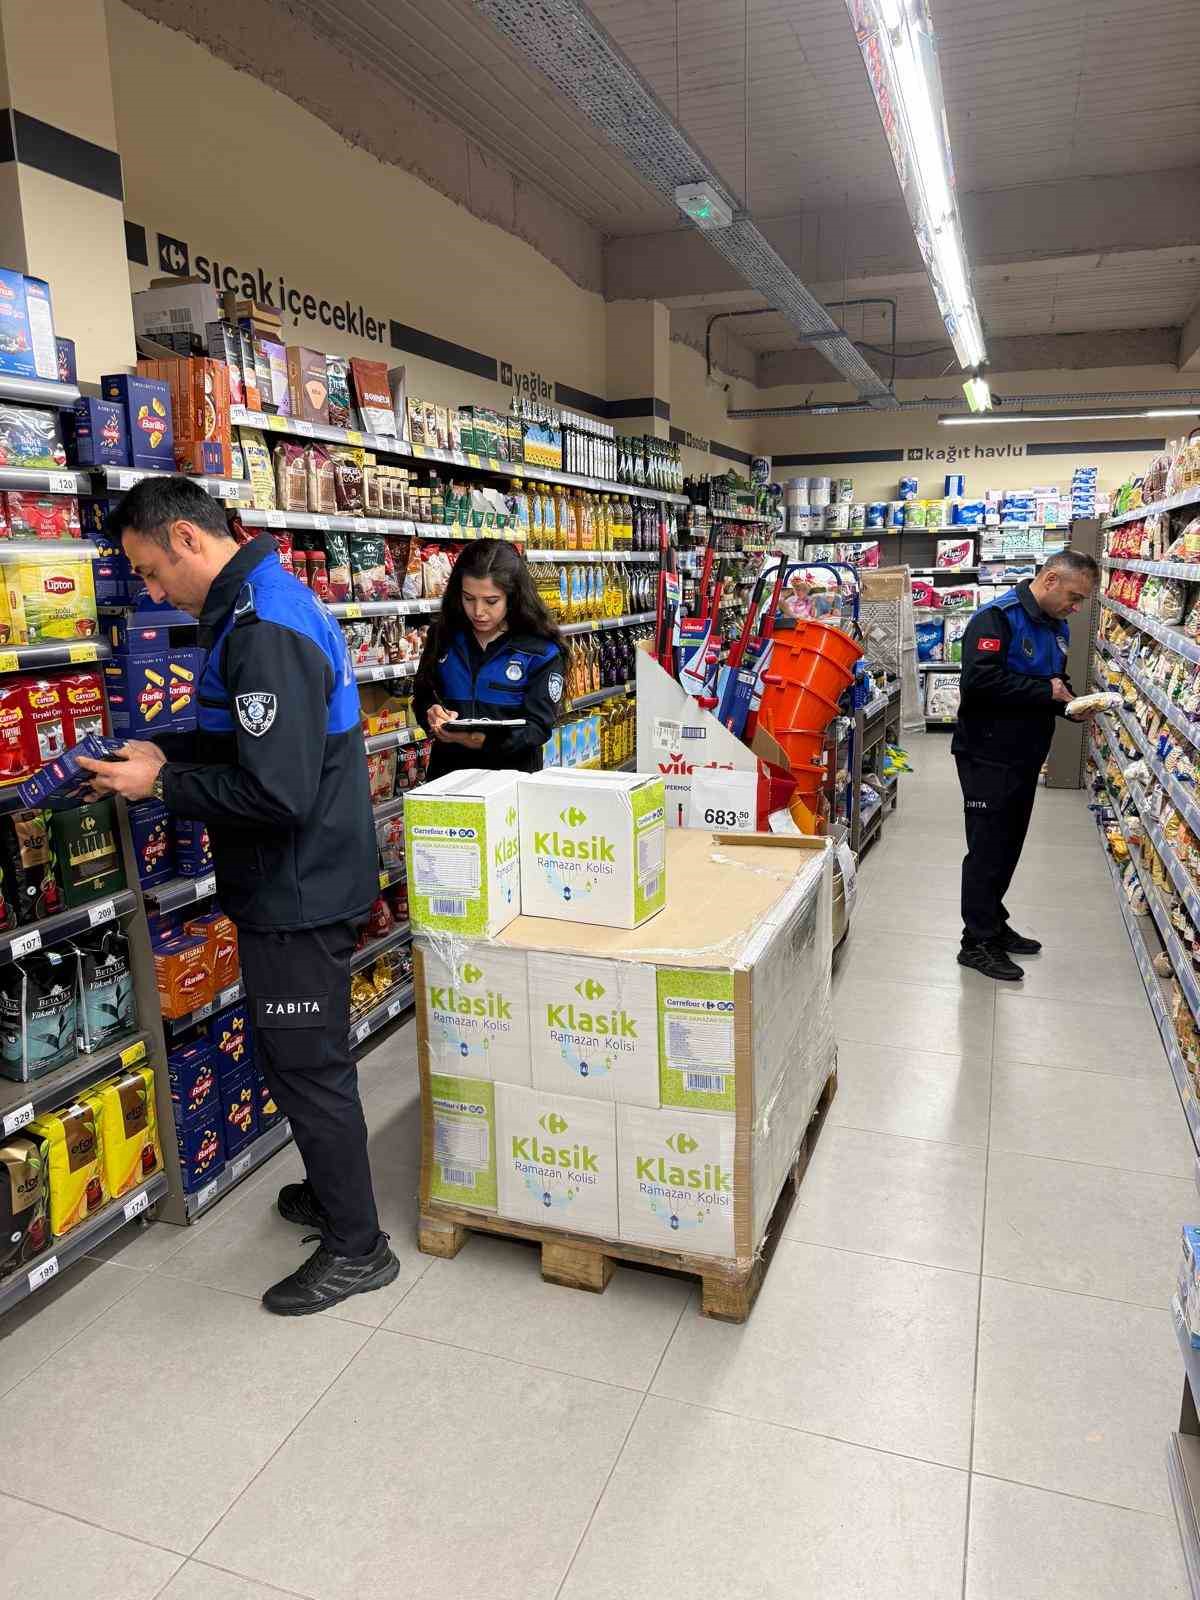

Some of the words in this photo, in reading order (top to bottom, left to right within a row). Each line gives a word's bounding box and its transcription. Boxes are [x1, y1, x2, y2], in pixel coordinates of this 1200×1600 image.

[195, 255, 274, 307] sıcak
[279, 276, 387, 343] içecekler
[514, 371, 553, 402] yağlar
[925, 445, 971, 463] kağıt
[974, 443, 1023, 458] havlu
[59, 479, 73, 489] 120
[47, 578, 74, 592] Lipton
[494, 836, 519, 867] Klas
[534, 831, 616, 863] Klasik
[537, 857, 582, 871] Ramazan
[586, 862, 615, 875] Kolisi
[97, 906, 112, 919] 209
[21, 937, 36, 951] 107
[265, 1001, 320, 1015] ZABITA
[430, 986, 513, 1020] Klasik
[666, 998, 700, 1008] Carrefour
[433, 1011, 478, 1027] Ramazan
[483, 1017, 512, 1032] Kolisi
[546, 1003, 639, 1039] Klasik
[550, 1030, 600, 1048] Ramazan
[605, 1037, 636, 1052] Kolisi
[13, 1111, 30, 1127] 329
[511, 1135, 600, 1173] Klasik
[515, 1160, 562, 1178] Ramazan
[567, 1171, 597, 1185] Kolisi
[635, 1155, 732, 1192] Klasik
[639, 1182, 692, 1200] Ramazan
[697, 1191, 729, 1206] Kolisi
[39, 1264, 54, 1280] 199
